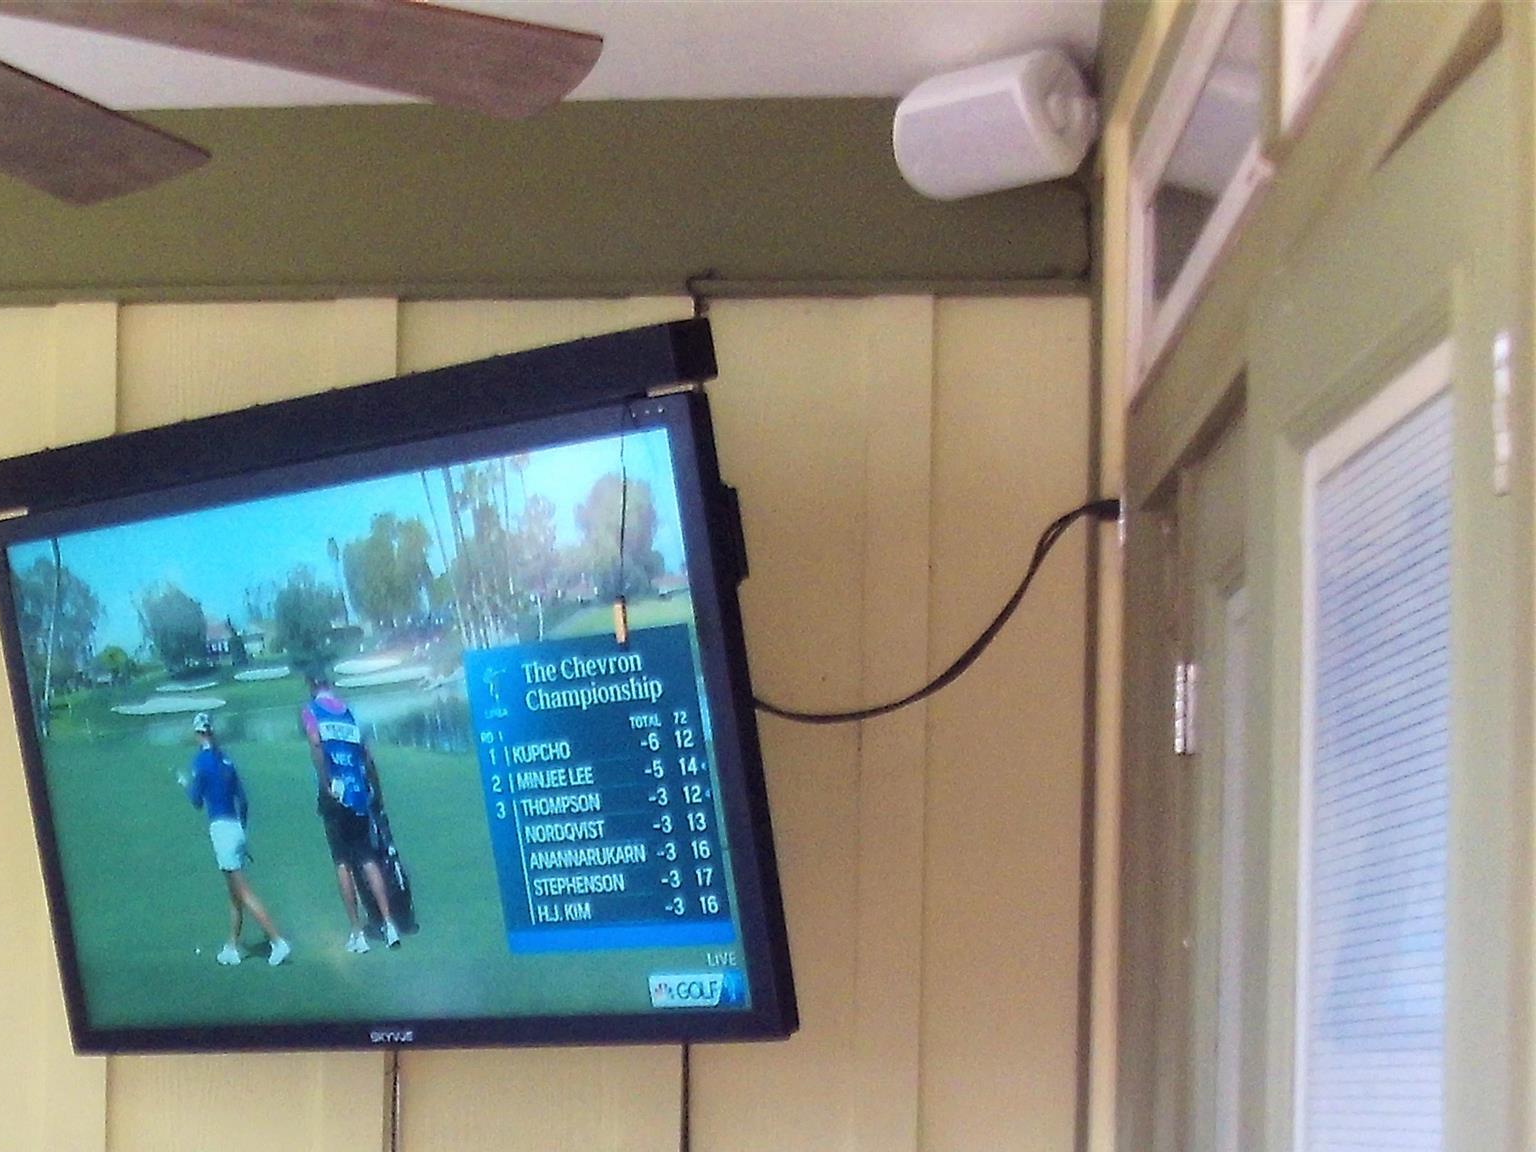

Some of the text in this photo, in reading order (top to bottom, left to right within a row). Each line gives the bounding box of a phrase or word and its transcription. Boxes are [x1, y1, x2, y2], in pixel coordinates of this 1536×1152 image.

[521, 654, 642, 684] The Chevron
[525, 676, 663, 712] Championship
[629, 713, 662, 729] TOTAL
[489, 729, 695, 765] 1 KUPCHO -6 12
[492, 756, 698, 793] 2 MINJEE LEE -5 14
[496, 785, 703, 819] 3 THOMPSON -3 12
[524, 812, 707, 843] NORDQVIST -3 13
[530, 840, 711, 870] ANANNARUKARN -3 16
[533, 868, 713, 896] STEPHENSON -3 17
[564, 902, 592, 920] KIM
[665, 897, 684, 915] -3
[700, 896, 719, 914] 16
[676, 981, 718, 1000] GOLF
